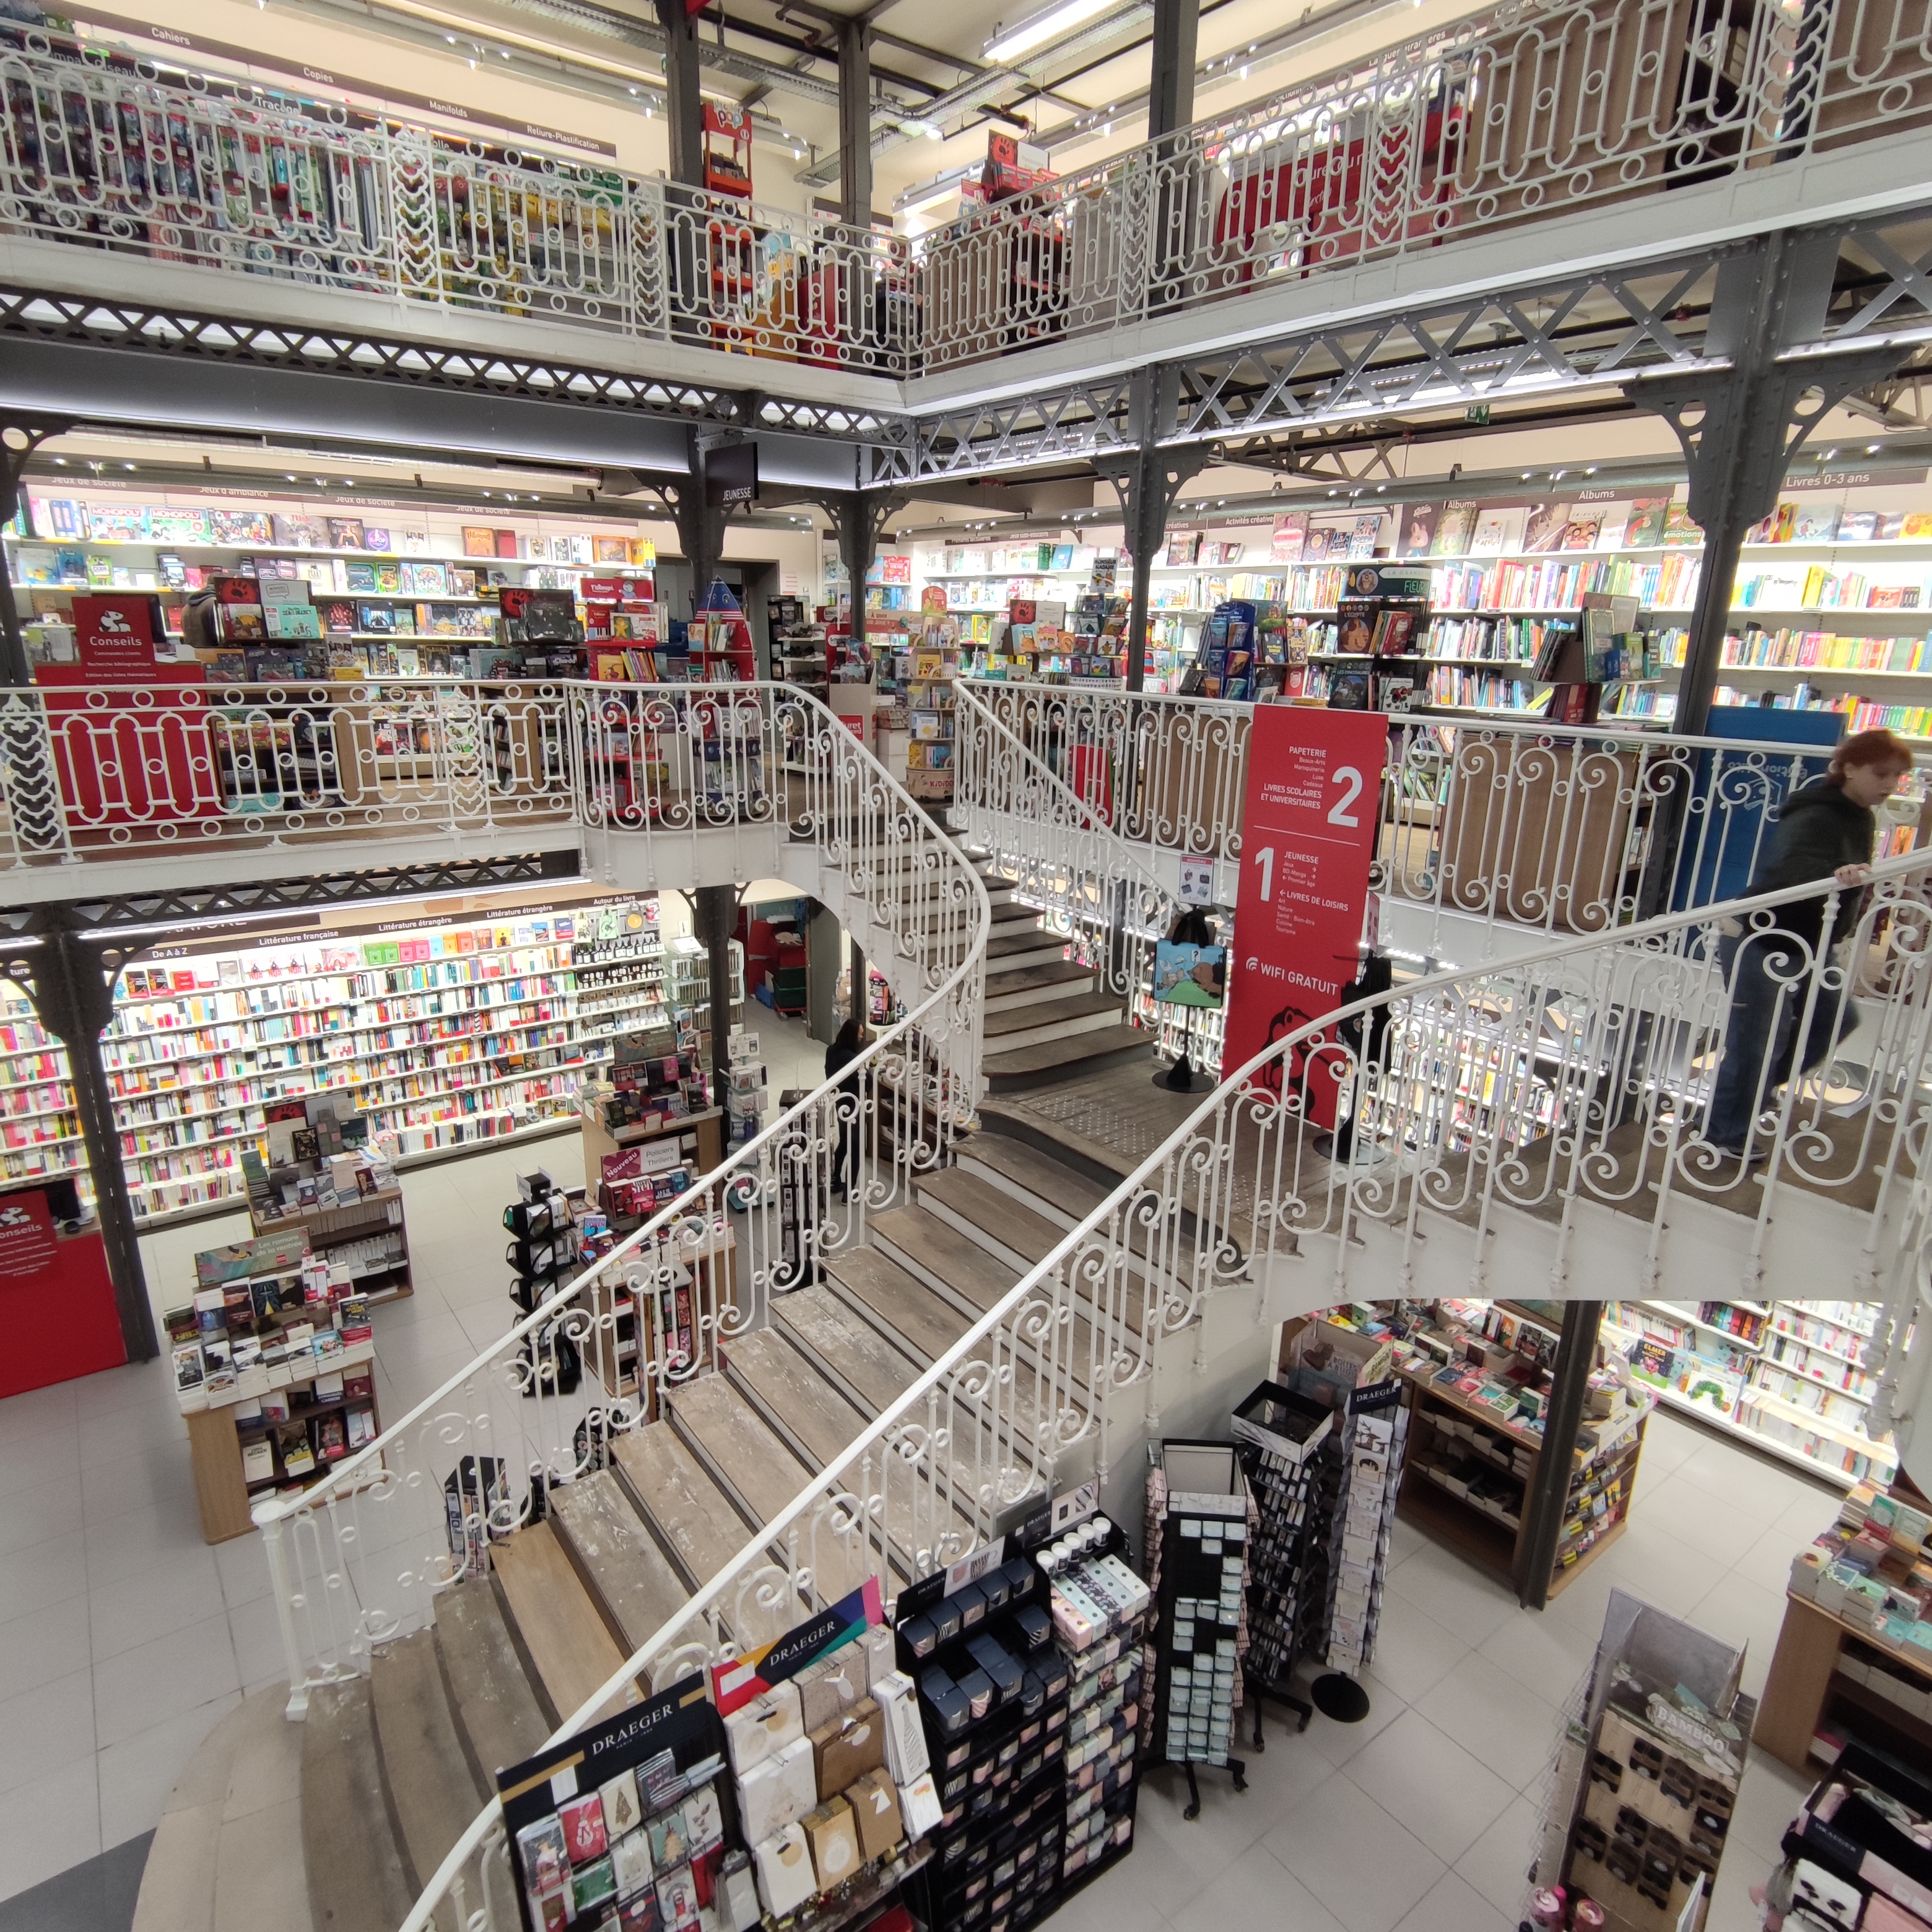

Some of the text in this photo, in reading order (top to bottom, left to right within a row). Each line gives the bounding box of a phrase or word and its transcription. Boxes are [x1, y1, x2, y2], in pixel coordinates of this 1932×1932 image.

[151, 27, 190, 46] Cahiers
[303, 67, 334, 84] Copies
[429, 100, 468, 119] Manifolds
[526, 124, 600, 151] Reliure-Plastification
[51, 476, 75, 484] Jeux
[77, 477, 89, 485] de
[1785, 472, 1870, 488] Livres 0-3 ans
[199, 487, 220, 495] Jeux
[722, 486, 752, 502] JEUNESSE
[1578, 489, 1615, 500] Albums
[334, 496, 352, 504] Jeux
[1448, 500, 1477, 510] Albums
[92, 508, 141, 517] MONOPOLY
[152, 509, 201, 520] MONOPOLY
[1225, 516, 1274, 526] Activités créative
[89, 636, 142, 646] Conseils
[1289, 746, 1326, 758] PAPETERIE
[1294, 764, 1325, 773] Maroquinerie
[1299, 757, 1326, 766] Beaux-Arts
[1264, 783, 1322, 799] LIVRES SCOLAIRES
[1303, 780, 1323, 788] Cadeaux
[1269, 794, 1321, 810] UNIVERSITAIRES
[1327, 765, 1363, 828] 2
[1284, 851, 1320, 864] JEUNESSE
[1255, 846, 1274, 902] 1
[1282, 868, 1307, 879] BD-Manga
[1287, 876, 1306, 885] Premier
[593, 896, 612, 905] Autour
[622, 894, 636, 902] livre
[1287, 890, 1349, 912] LIVRES DE LOISIRS
[485, 905, 553, 918] Littérature étrangère
[1277, 904, 1293, 913] Nature
[378, 916, 453, 932] Littérature étrangère
[1276, 918, 1293, 928] Cuisine
[1277, 911, 1315, 926] Santé Bien-être
[259, 930, 339, 946] Littérature française
[1276, 925, 1296, 936] Tourisme
[152, 949, 164, 959] De
[1260, 962, 1339, 996] WIFI GRATUIT
[606, 1146, 674, 1178] Nouveau Policiers
[647, 1155, 674, 1167] Thrillers
[0, 1224, 43, 1239] onseils
[256, 1248, 266, 1256] de
[277, 1240, 303, 1252] rentrée
[272, 1235, 299, 1246] romans
[1643, 1342, 1666, 1357] ELMER
[1356, 1386, 1397, 1403] DRAEGER
[1027, 1510, 1051, 1527] DRAEGER
[918, 1577, 946, 1595] DRAEGER
[770, 1621, 836, 1667] DRAEGER
[591, 1704, 674, 1756] DRAEGER
[1657, 1705, 1725, 1753] BAMBOO
[1814, 1822, 1856, 1853] DRAEGER
